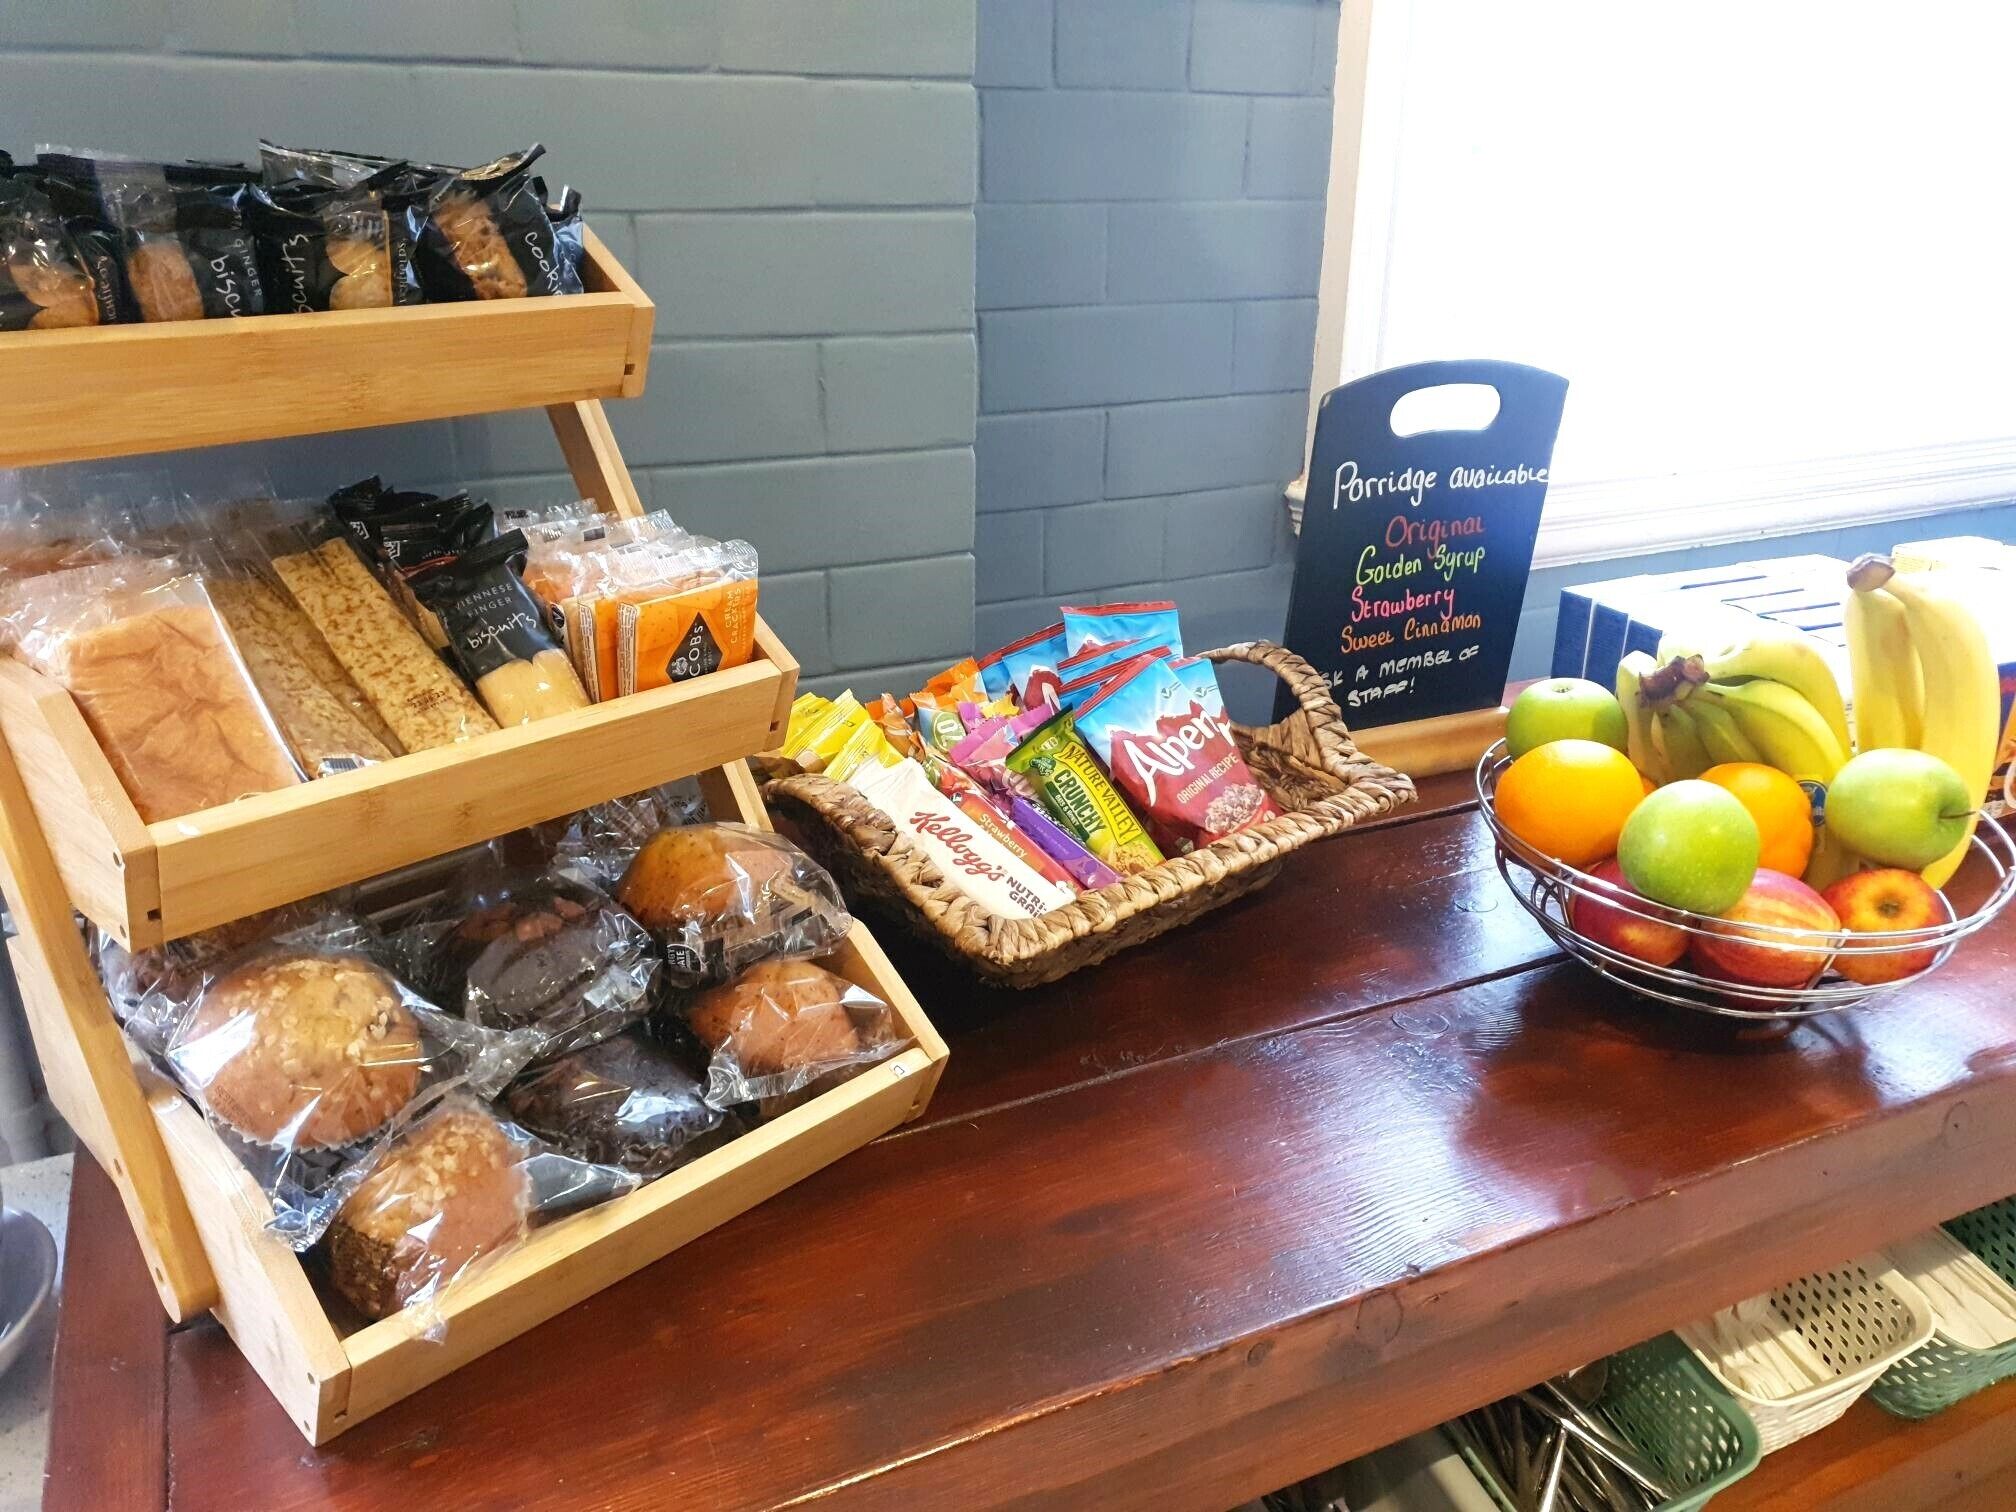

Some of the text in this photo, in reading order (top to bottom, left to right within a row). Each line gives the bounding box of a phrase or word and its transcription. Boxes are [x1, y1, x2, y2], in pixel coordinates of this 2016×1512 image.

[234, 238, 263, 297] GINGER
[1333, 460, 1550, 510] Porridge available
[1385, 515, 1486, 560] Original
[1356, 544, 1486, 586] Golden Syrup
[456, 583, 514, 611] VIENNESE
[467, 596, 513, 618] FINGER
[1351, 585, 1455, 623] Strawberry
[466, 612, 537, 649] biscuits
[1341, 614, 1481, 654] Sweet Cinnamon
[1322, 669, 1344, 690] SK
[1355, 664, 1370, 683] A
[1458, 644, 1481, 661] OF
[1347, 676, 1416, 707] STAFF!
[1122, 709, 1221, 808] Alpen
[1176, 752, 1240, 804] ORIGINAL RECIPE
[1053, 768, 1108, 834] CRUNCHY
[1063, 744, 1140, 838] NATURE VALLEY
[909, 811, 1006, 882] Kellogg's
[979, 813, 1028, 859] Strawberry
